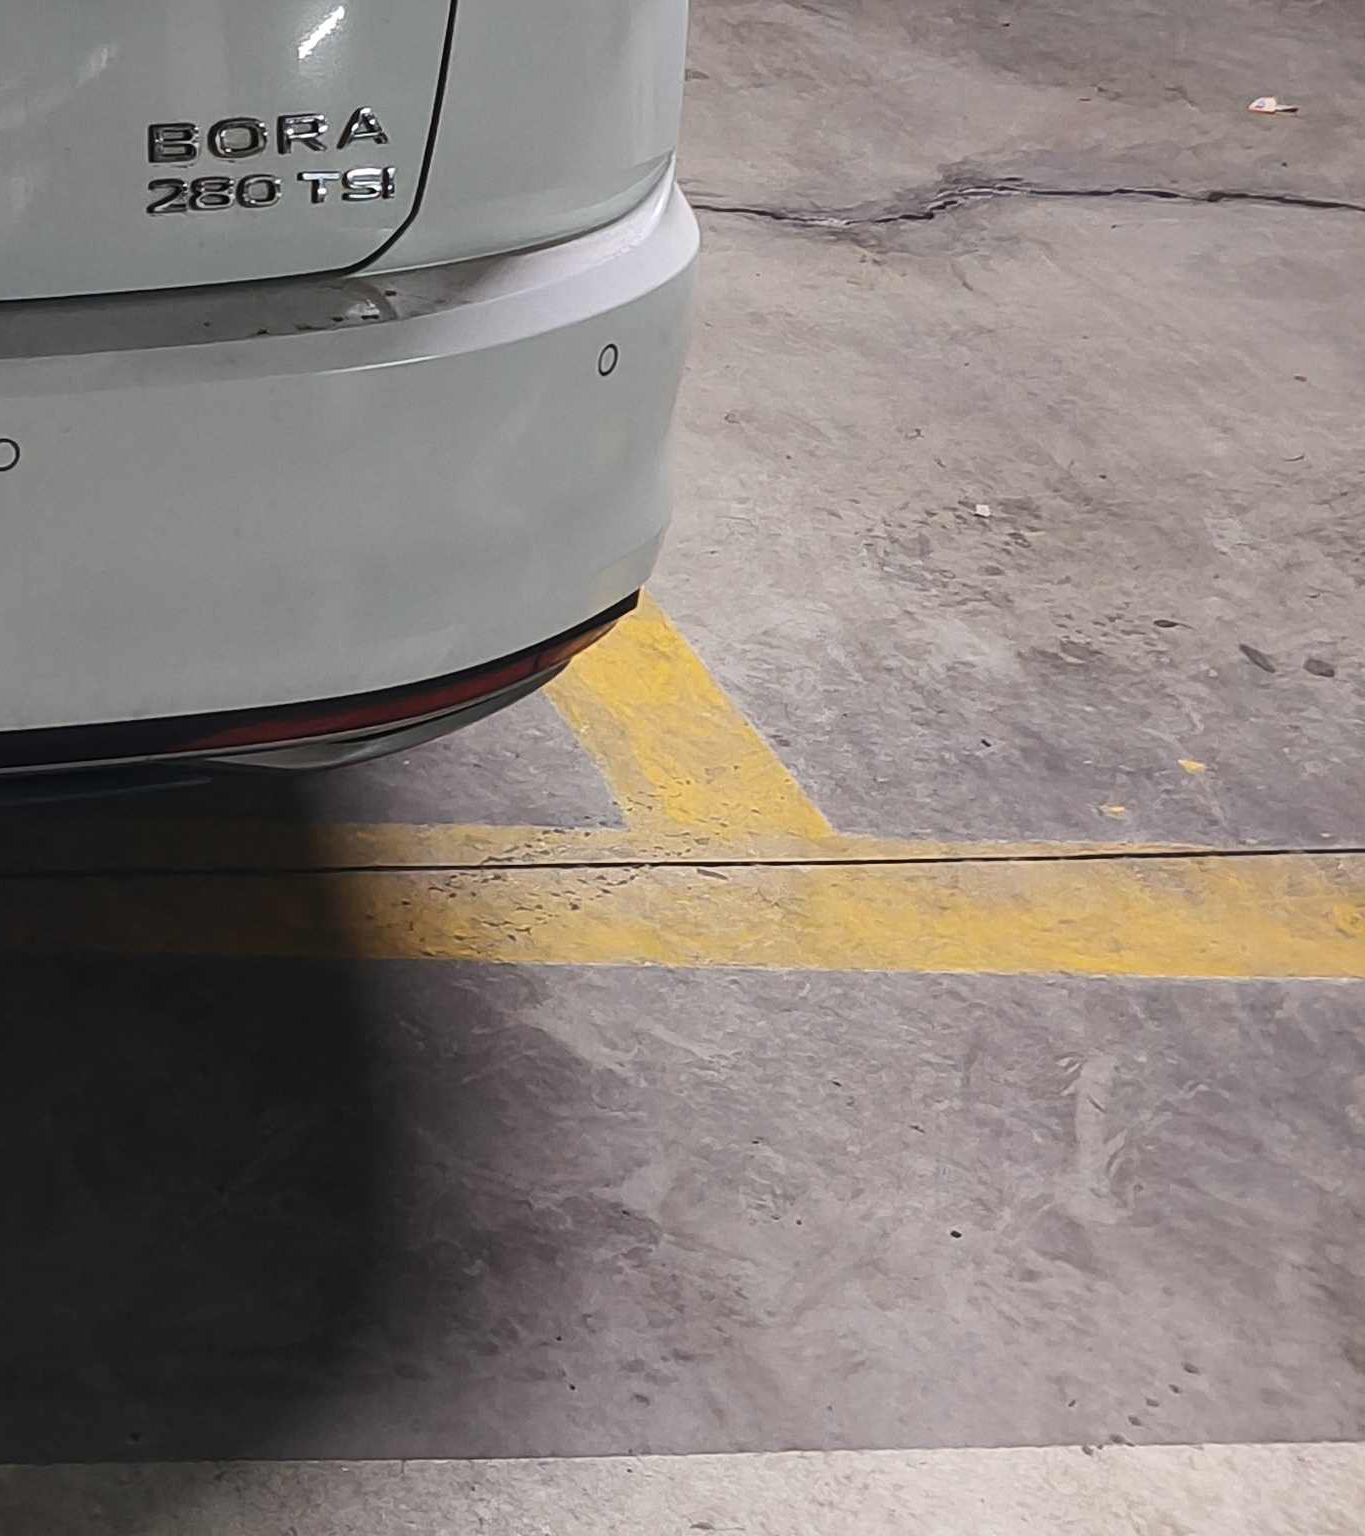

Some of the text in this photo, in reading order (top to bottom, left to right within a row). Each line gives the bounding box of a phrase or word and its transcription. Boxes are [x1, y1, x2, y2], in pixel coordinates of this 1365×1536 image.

[147, 106, 389, 163] BORA
[146, 166, 396, 215] 280 TSI
